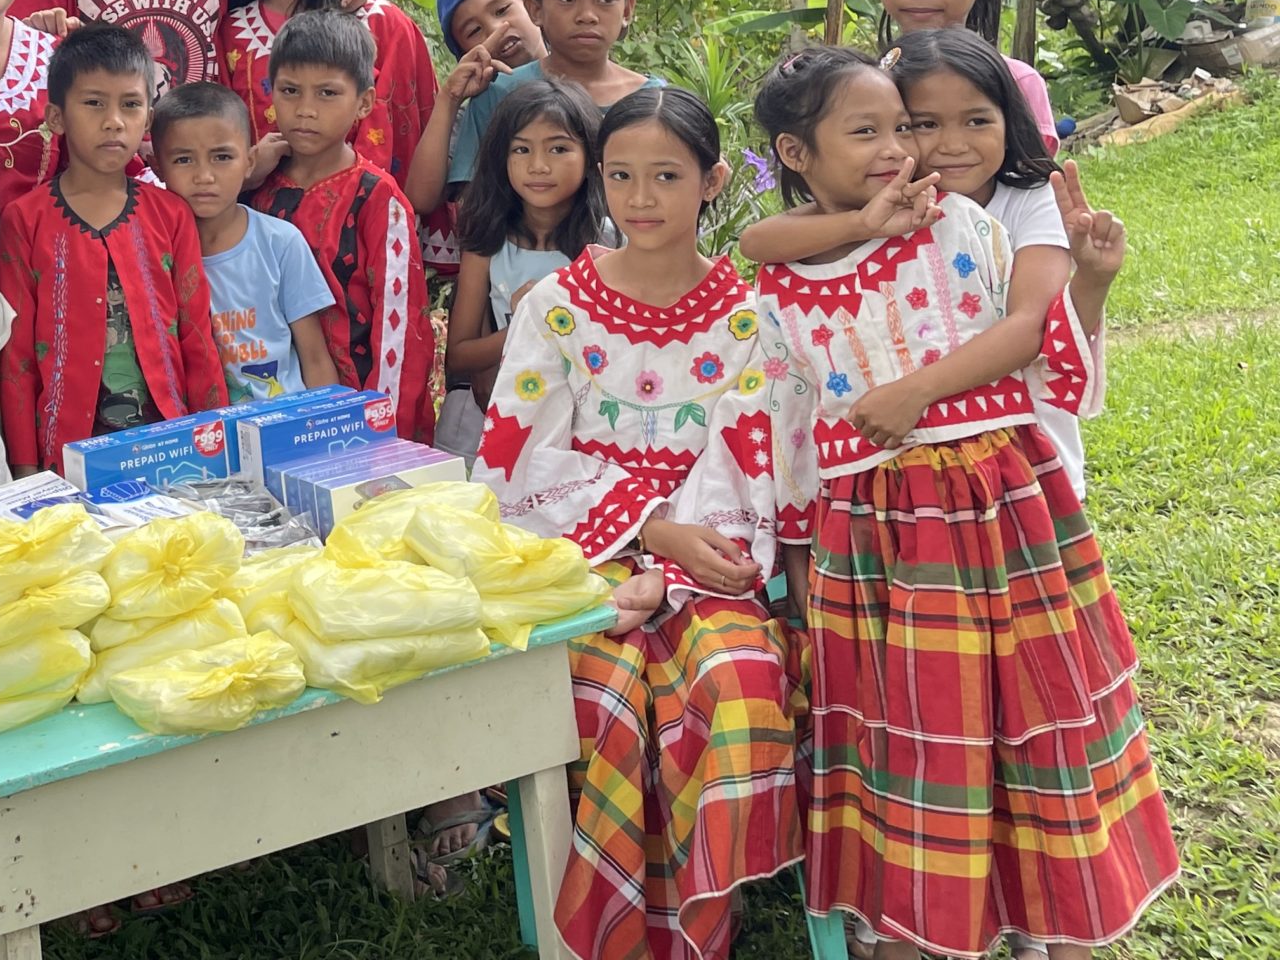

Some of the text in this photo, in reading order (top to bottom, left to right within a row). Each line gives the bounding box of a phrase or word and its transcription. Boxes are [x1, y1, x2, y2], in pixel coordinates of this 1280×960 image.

[102, 0, 130, 24] SE
[212, 306, 256, 333] SHING
[294, 420, 365, 446] PREPAID WIFI
[120, 445, 193, 471] PREPAID WIFI
